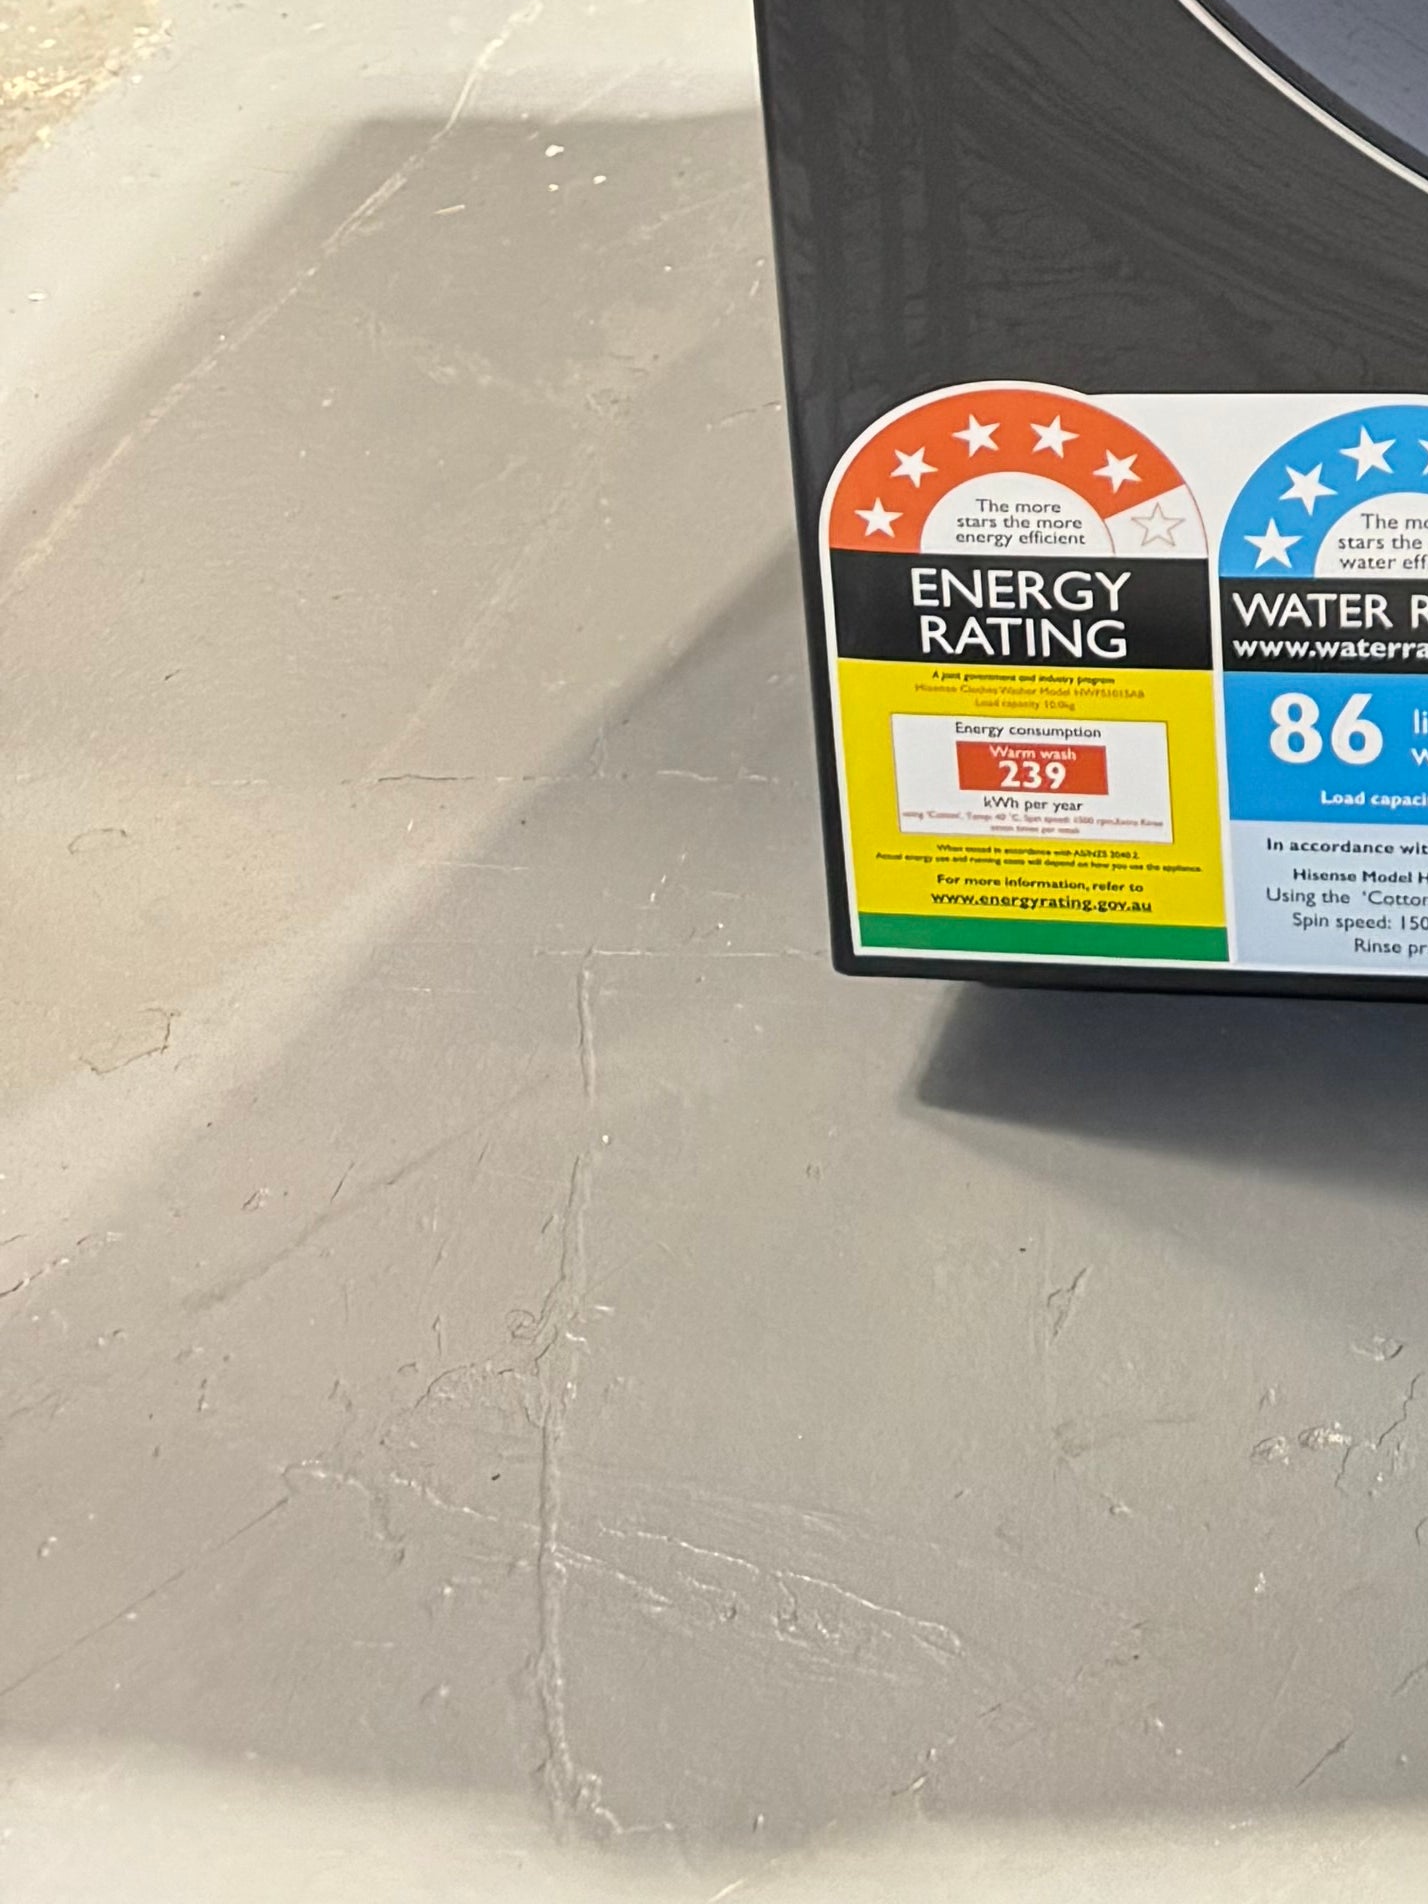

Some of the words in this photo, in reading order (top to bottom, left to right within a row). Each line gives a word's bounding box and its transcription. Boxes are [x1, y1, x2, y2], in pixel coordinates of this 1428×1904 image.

[975, 498, 1010, 513] The
[1014, 501, 1062, 514] more
[956, 515, 998, 529] stars
[1003, 515, 1031, 529] the
[1036, 518, 1083, 530] more
[1360, 512, 1400, 531] The
[955, 532, 1013, 548] energy
[1018, 530, 1086, 545] efficient
[1337, 534, 1386, 552] stars
[1390, 533, 1425, 552] the
[1338, 554, 1397, 571] water
[909, 567, 1132, 612] ENERGY
[1231, 591, 1394, 630] WATER
[919, 614, 1128, 659] RATING
[954, 722, 1004, 738] Energy
[1008, 725, 1102, 741] consumption
[1269, 691, 1384, 766] 86
[988, 744, 1036, 760] Warm
[1040, 747, 1077, 761] wash
[998, 759, 1067, 790] 239
[983, 795, 1020, 810] kWh
[1024, 800, 1048, 813] per
[1053, 800, 1084, 813] year
[1319, 789, 1366, 806] Load
[1266, 837, 1284, 852] In
[1289, 839, 1395, 855] accordance
[936, 873, 961, 885] For
[964, 876, 1002, 887] more
[1004, 876, 1090, 892] information,
[1092, 880, 1125, 892] refer
[1128, 882, 1144, 893] to
[1292, 867, 1357, 883] Hisense
[1361, 869, 1413, 884] Model
[930, 892, 1152, 913] www.energyrating.gov.au
[1265, 886, 1317, 908] Using
[1321, 888, 1351, 905] the
[1292, 912, 1330, 930] Spin
[1335, 913, 1393, 932] speed:
[1353, 937, 1402, 955] Rinse
